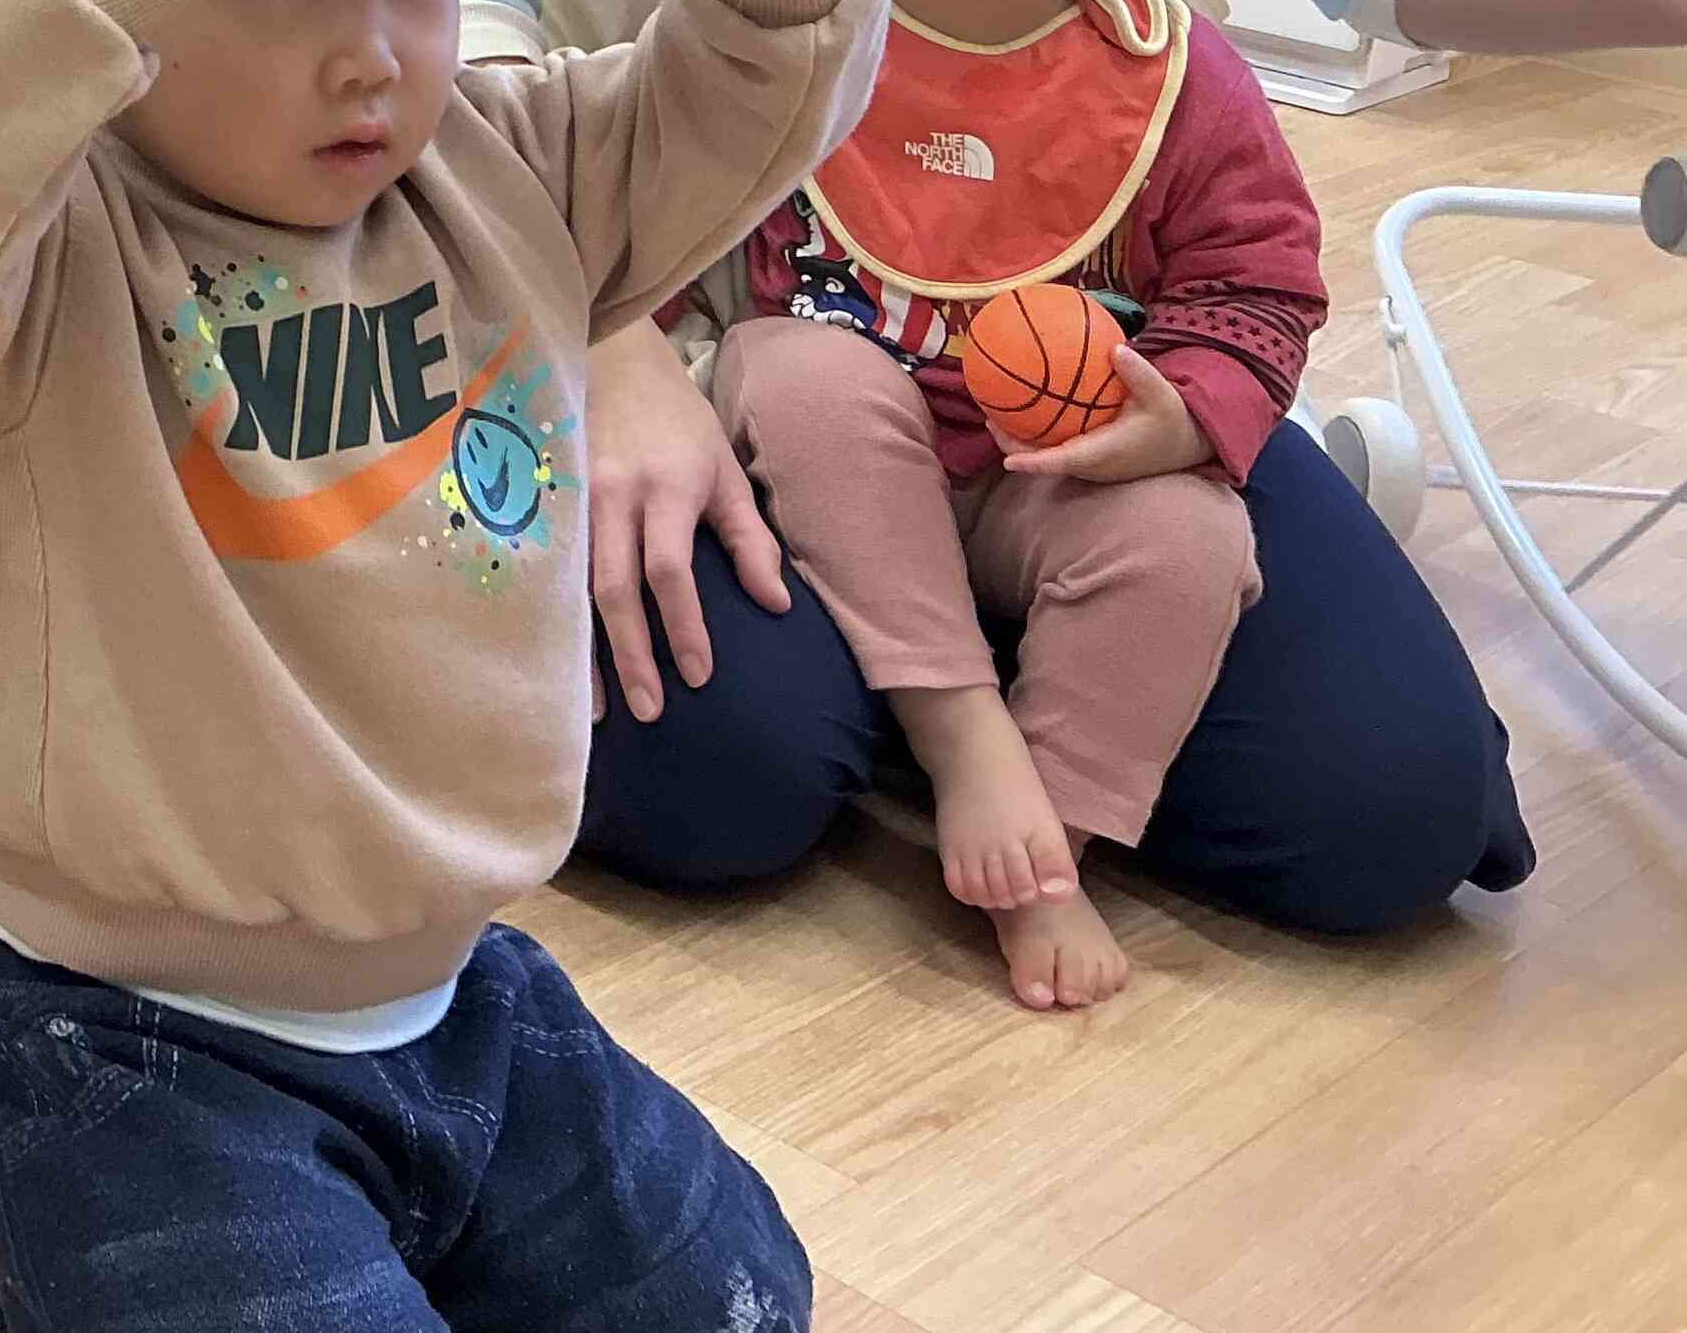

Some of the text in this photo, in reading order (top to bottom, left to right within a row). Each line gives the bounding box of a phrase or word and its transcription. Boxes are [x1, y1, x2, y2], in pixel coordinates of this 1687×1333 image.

[929, 132, 963, 147] THE
[905, 141, 963, 162] NORTH
[922, 156, 963, 176] FACE
[220, 281, 457, 460] NIKE
